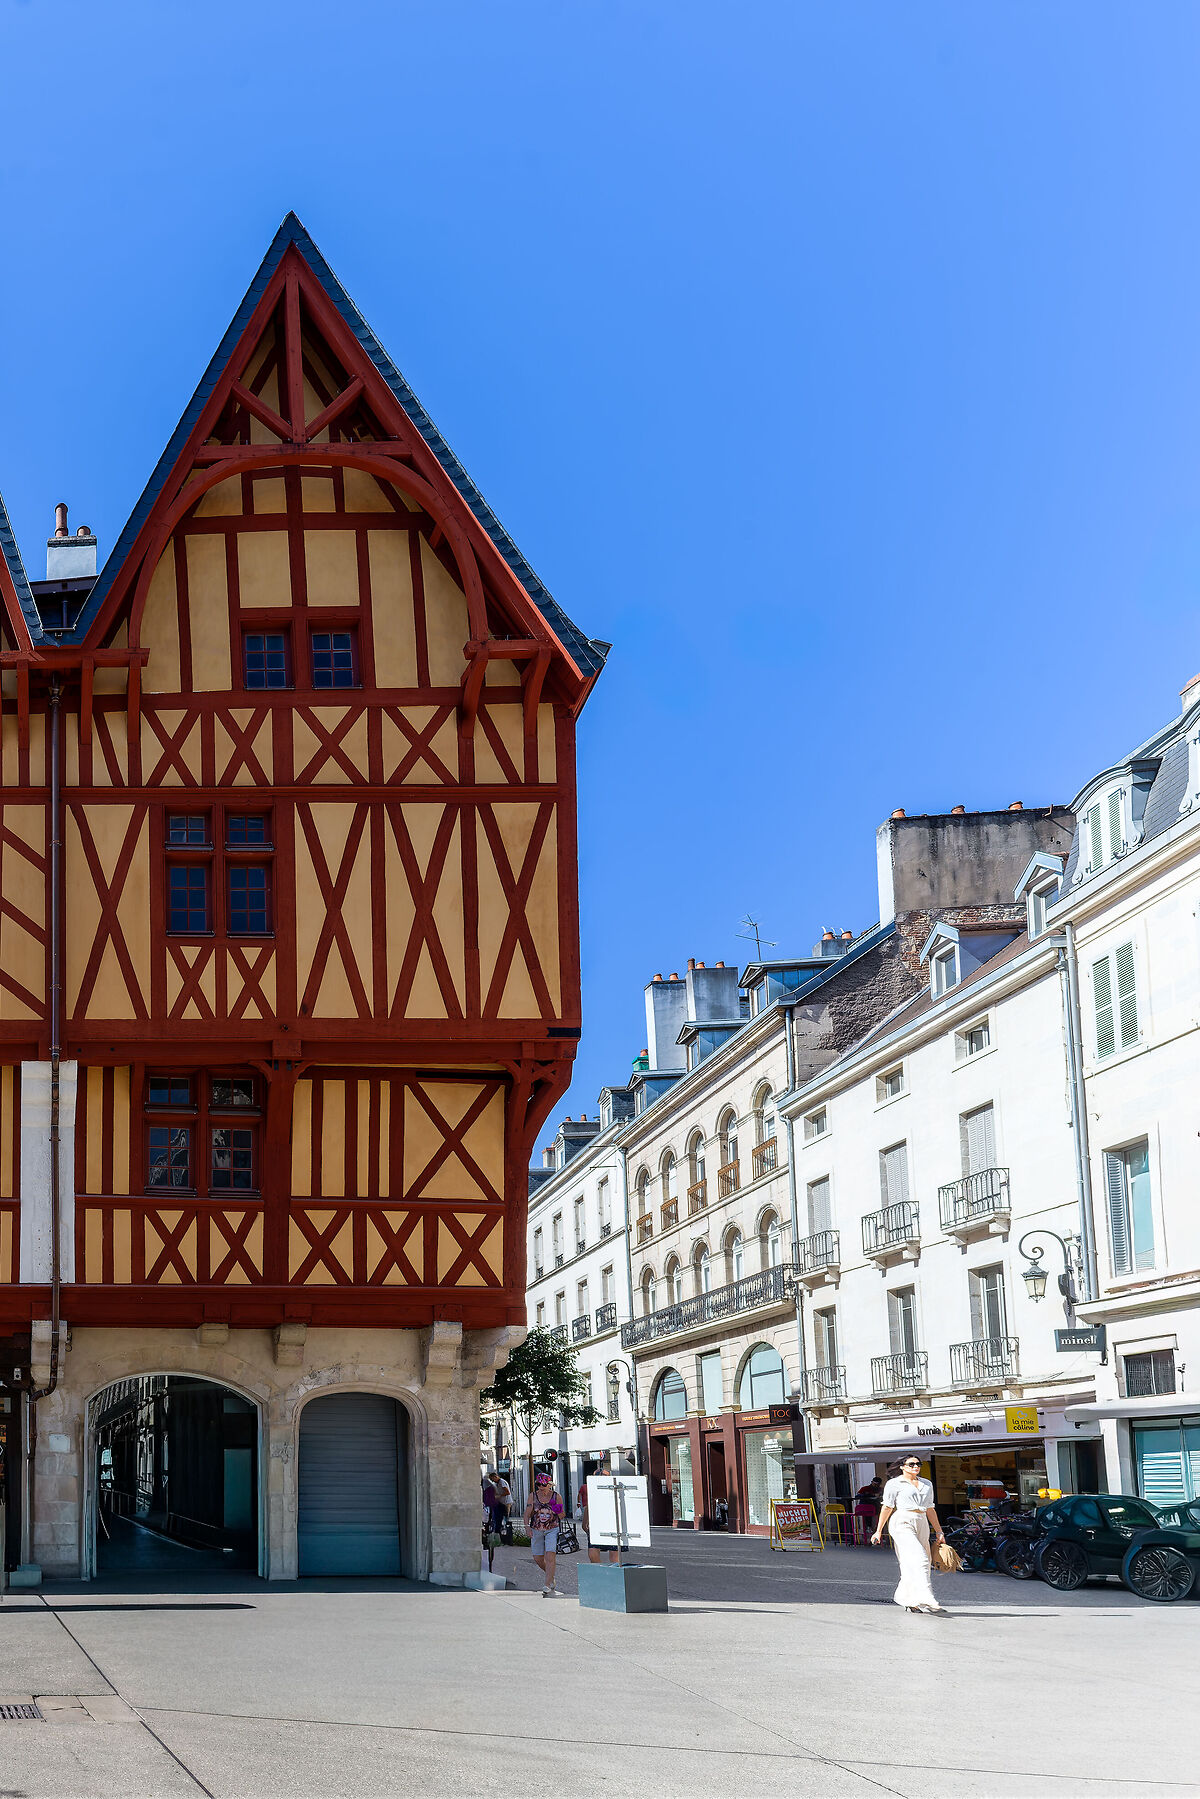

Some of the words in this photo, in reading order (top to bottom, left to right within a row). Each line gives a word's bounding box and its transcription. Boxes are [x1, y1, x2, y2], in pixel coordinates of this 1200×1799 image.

[955, 1422, 983, 1434] câline
[777, 1508, 808, 1519] MUCHO
[777, 1515, 810, 1528] PLAISIR
